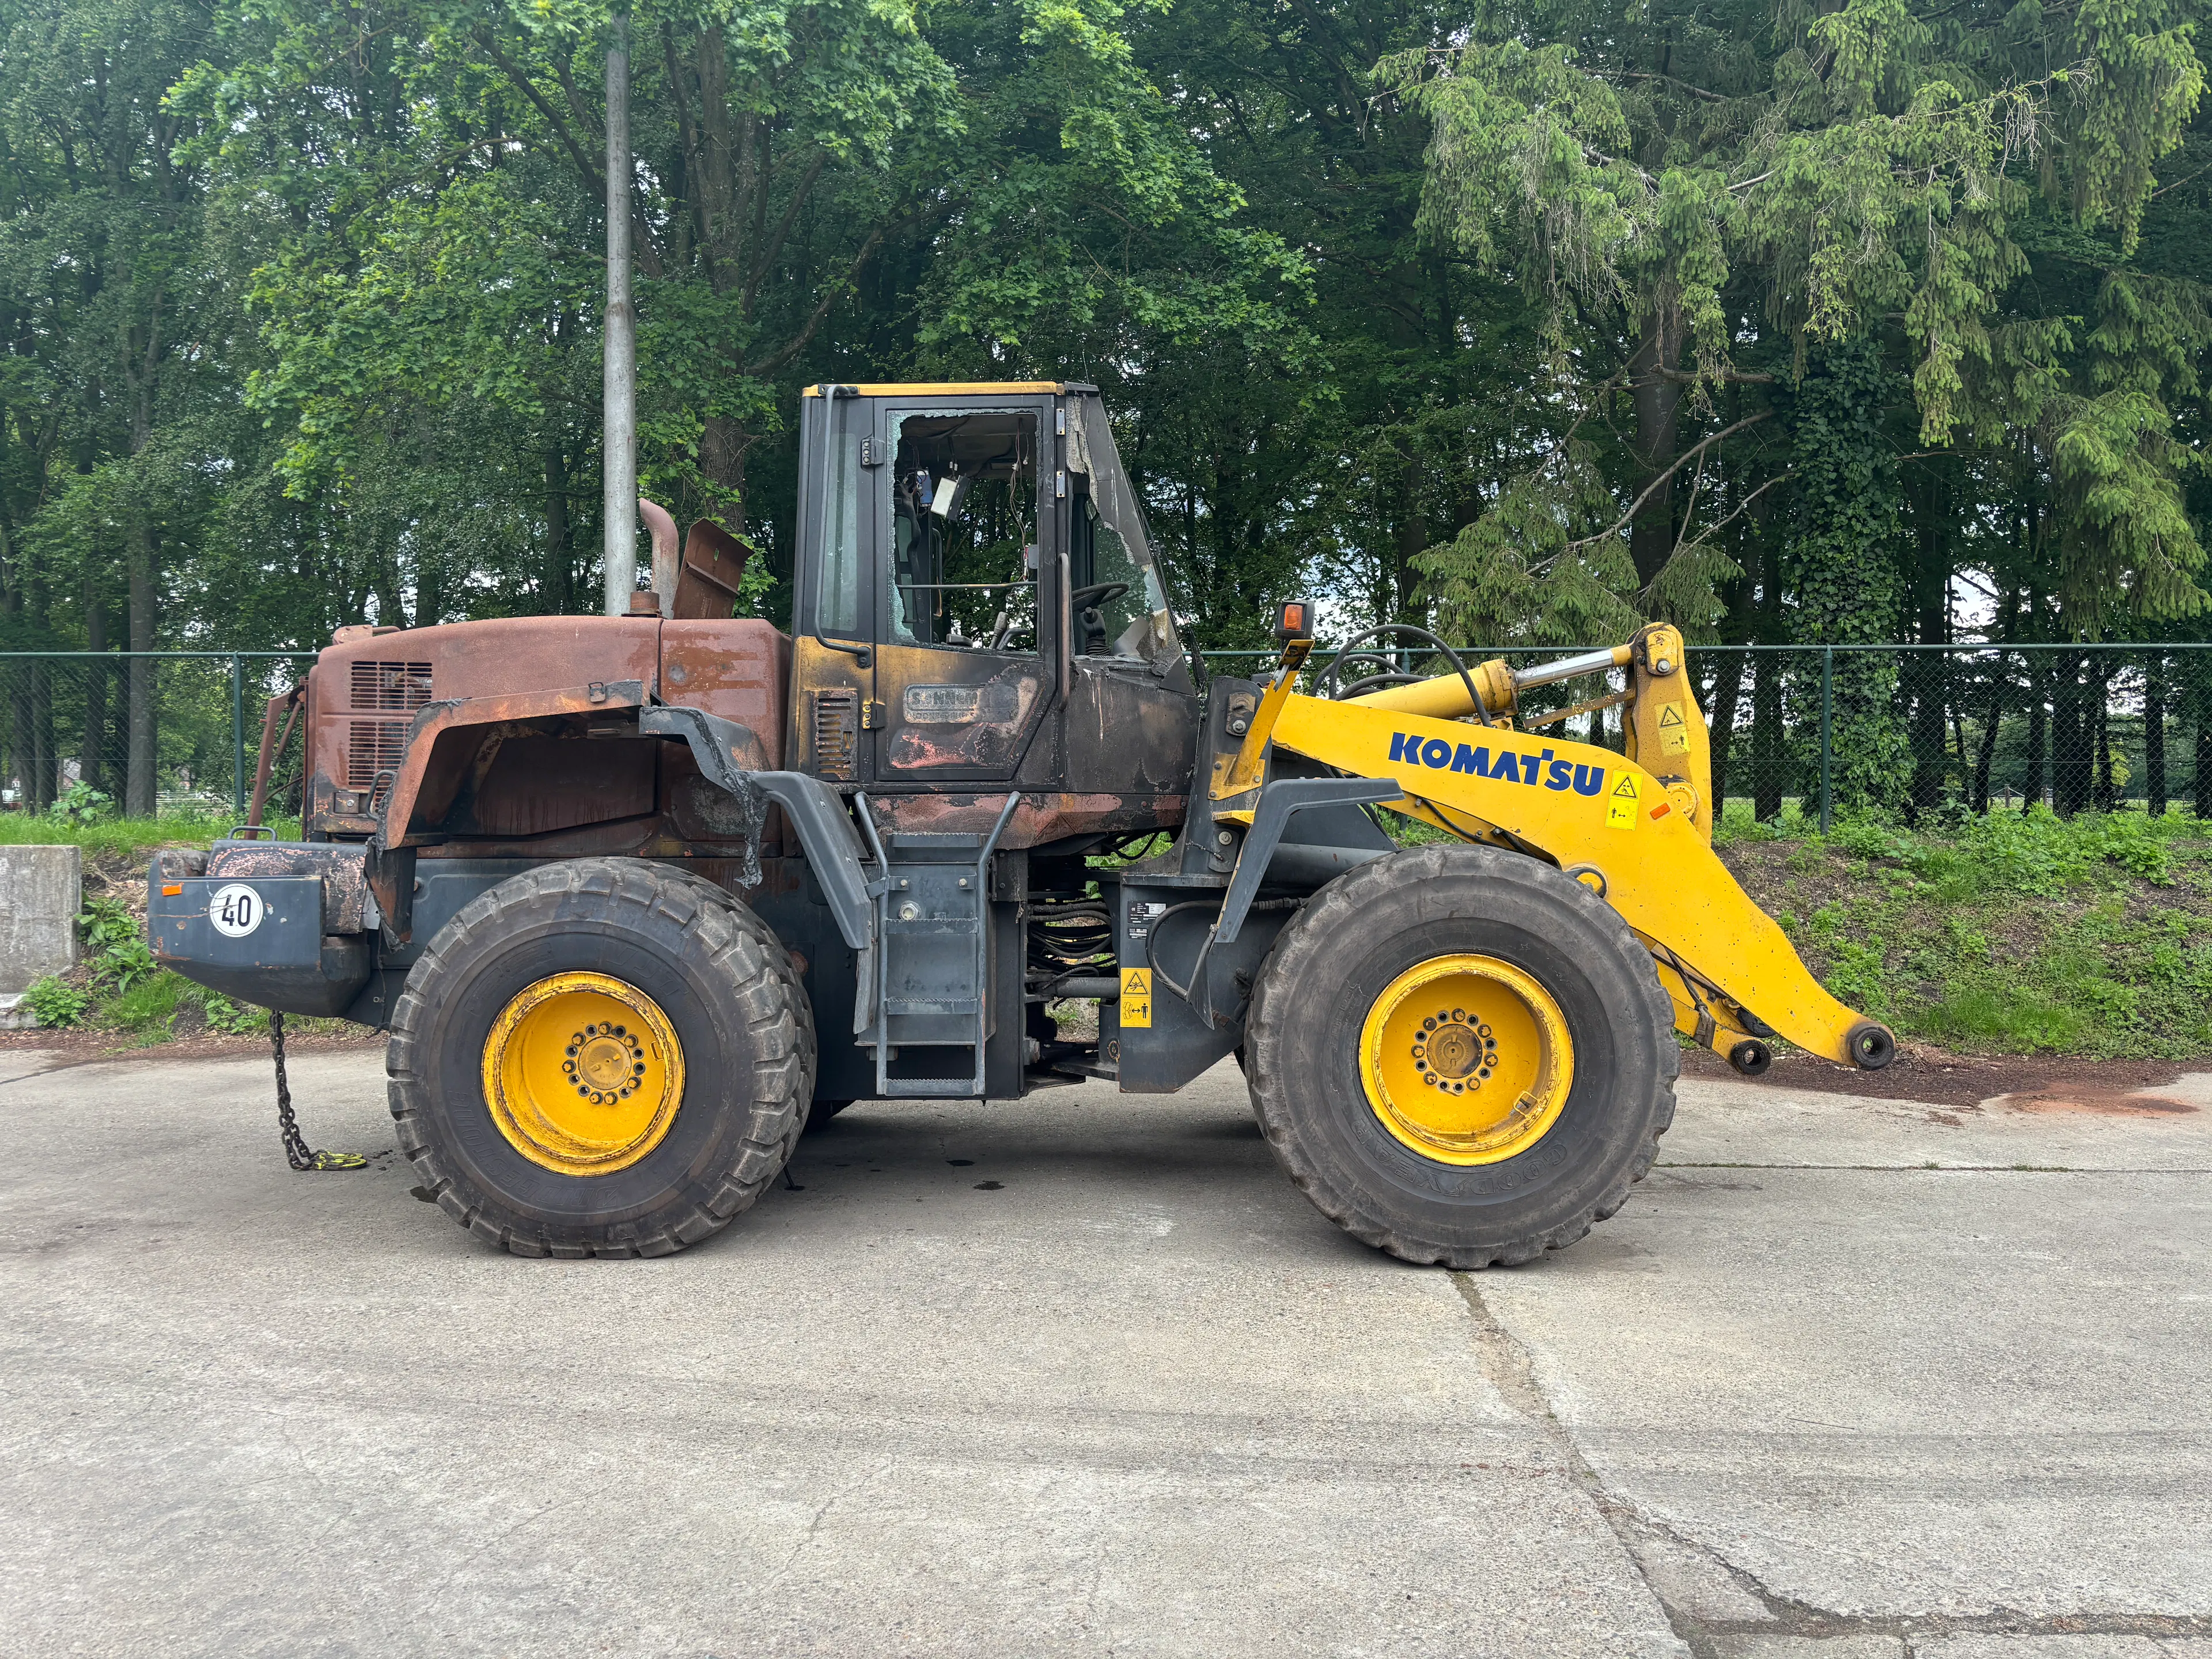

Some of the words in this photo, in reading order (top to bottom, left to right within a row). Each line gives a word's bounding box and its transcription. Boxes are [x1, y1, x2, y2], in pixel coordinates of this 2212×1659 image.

[1388, 732, 1605, 796] KOMATSU
[222, 894, 251, 927] 40
[1351, 1118, 1567, 1198] GOODYEAR
